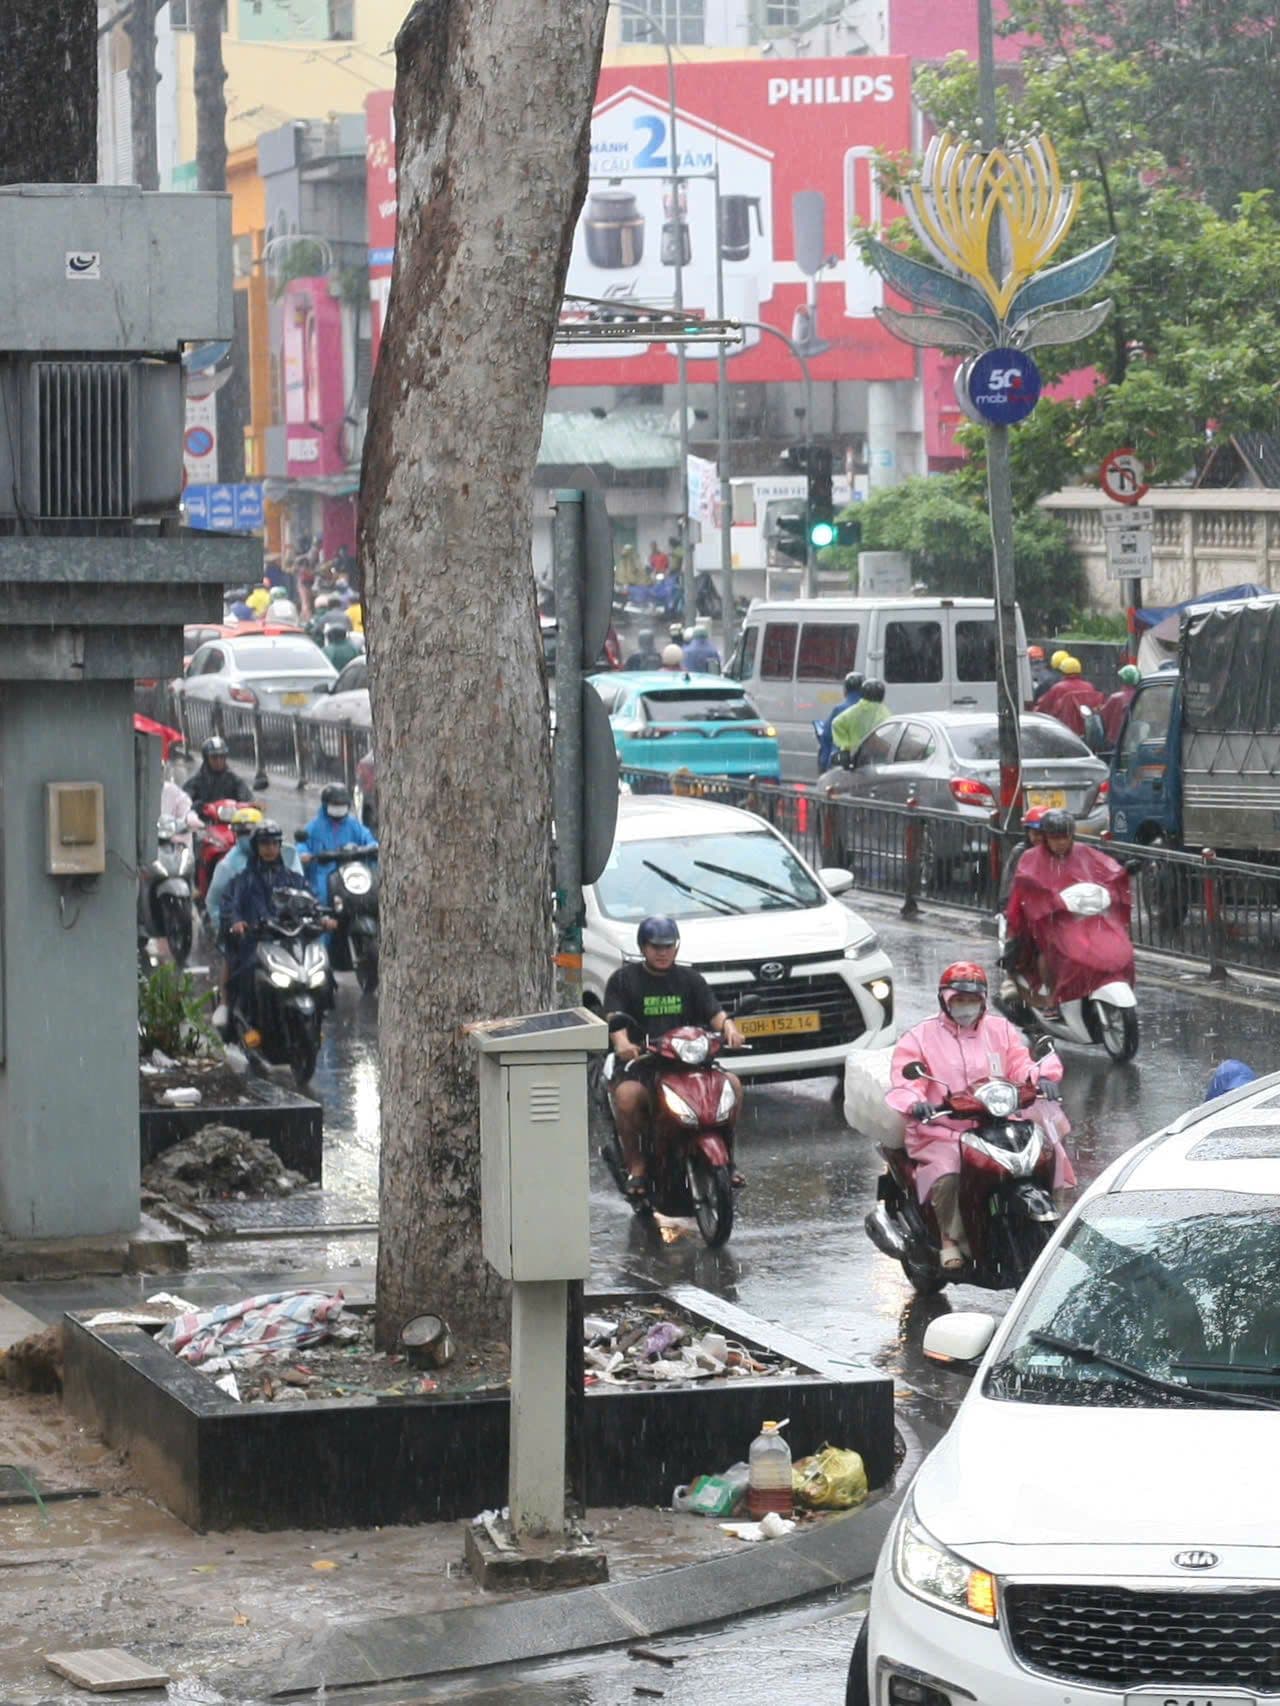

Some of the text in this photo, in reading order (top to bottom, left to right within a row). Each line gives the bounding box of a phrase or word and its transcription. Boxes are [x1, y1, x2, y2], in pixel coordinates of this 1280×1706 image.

[768, 74, 894, 106] PHILIPS
[634, 115, 667, 168] 2
[1177, 1552, 1213, 1565] KIA
